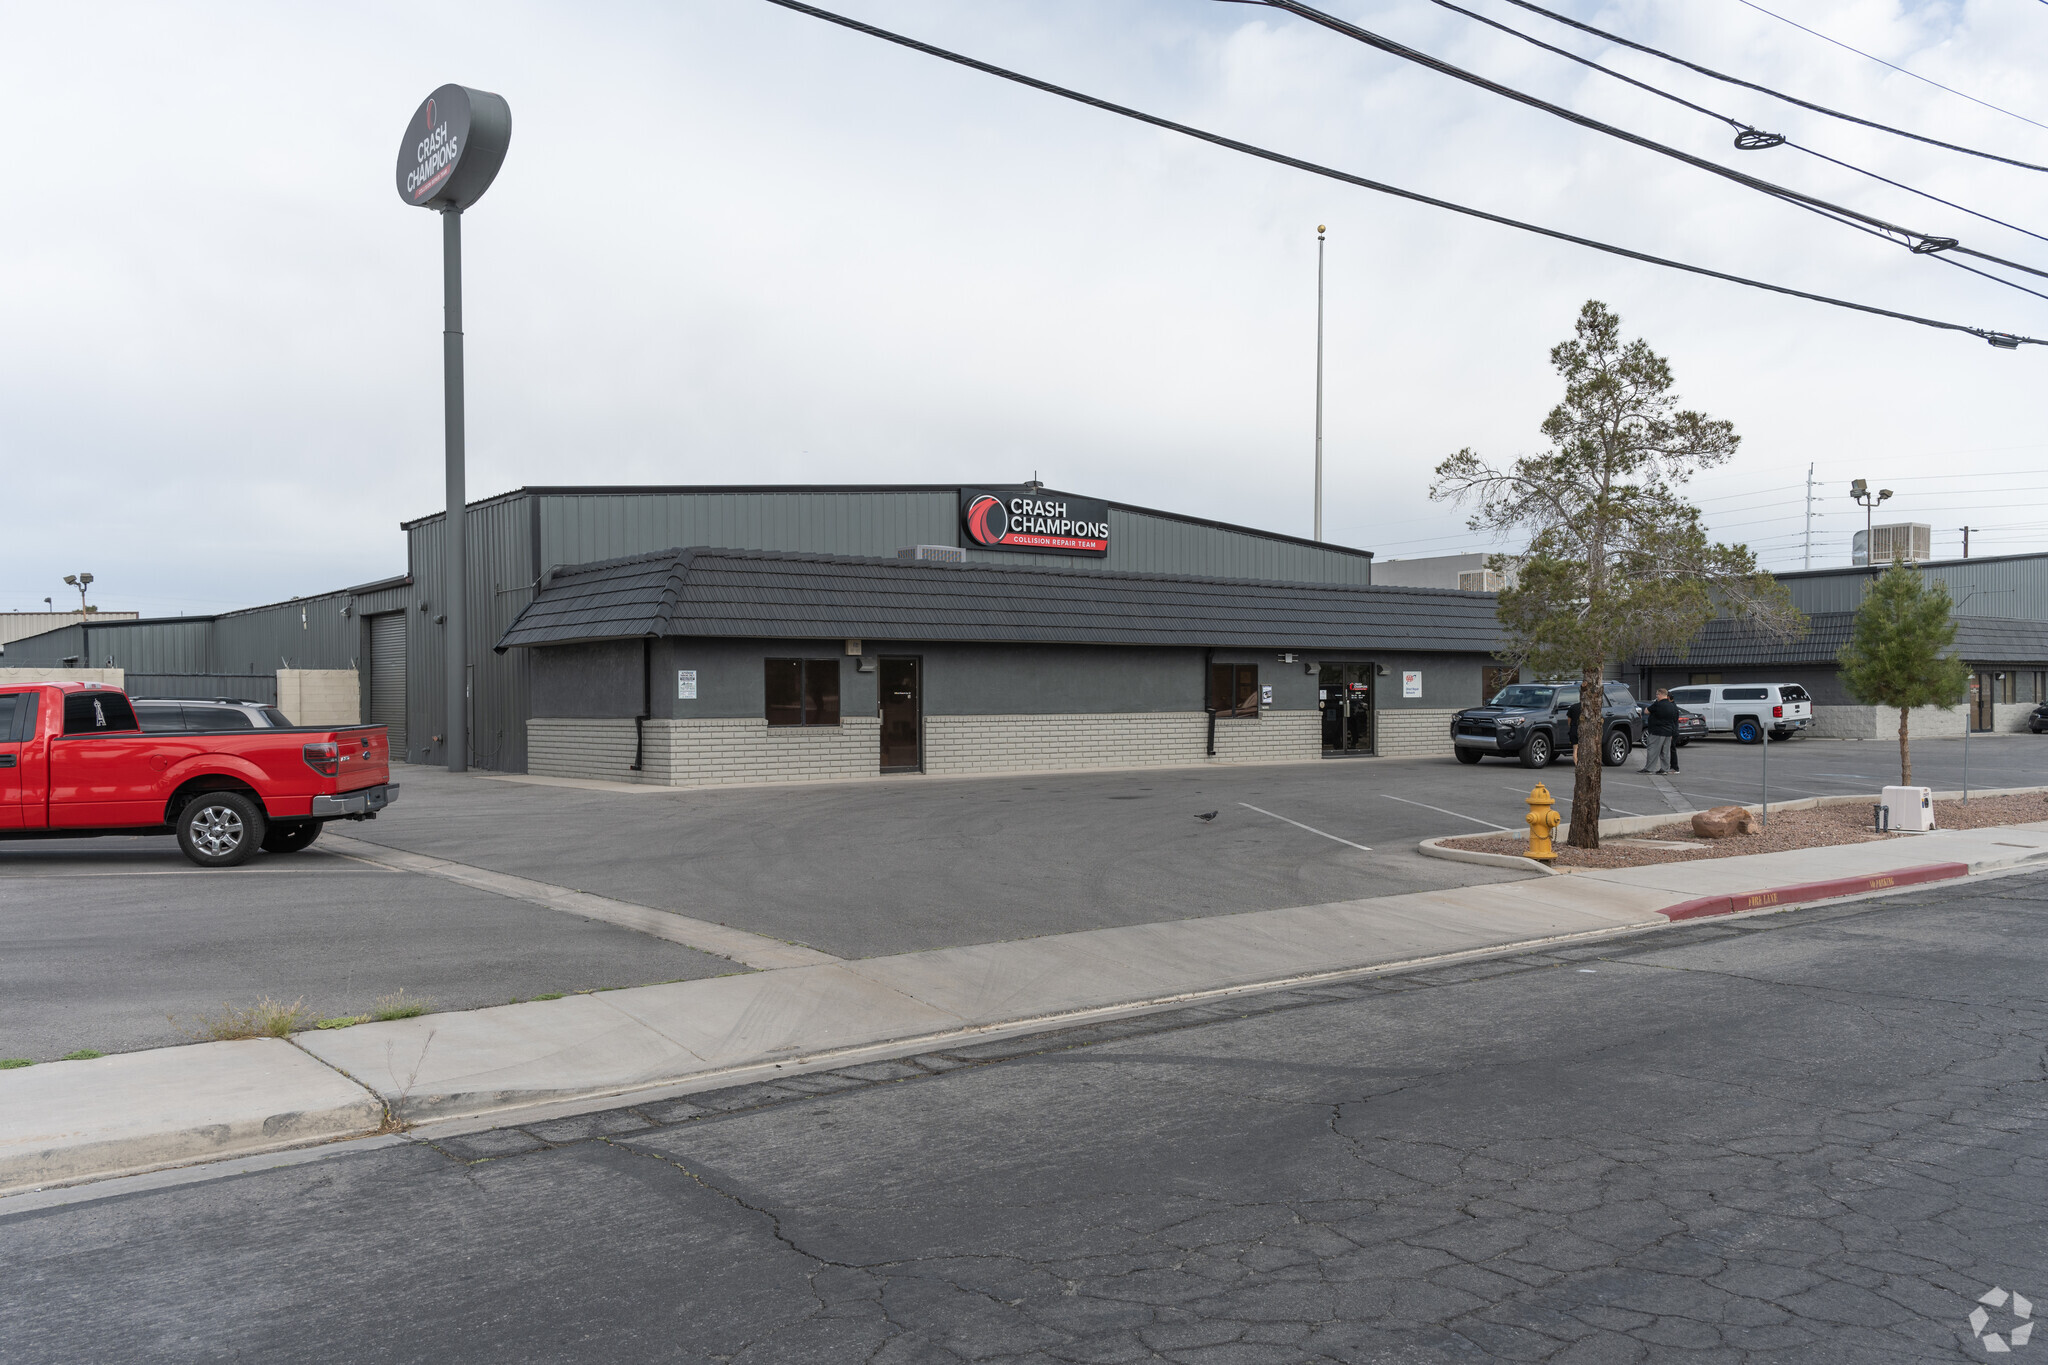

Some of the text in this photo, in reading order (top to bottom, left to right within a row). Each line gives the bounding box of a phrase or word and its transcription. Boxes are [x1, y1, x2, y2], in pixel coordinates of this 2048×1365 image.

[418, 121, 447, 163] CRASH
[407, 136, 458, 193] CHAMPIONS
[1010, 498, 1067, 518] CRASH
[1010, 515, 1109, 538] CHAMPIONS
[1013, 536, 1050, 545] COLLISION
[1052, 539, 1076, 547] REPAIR
